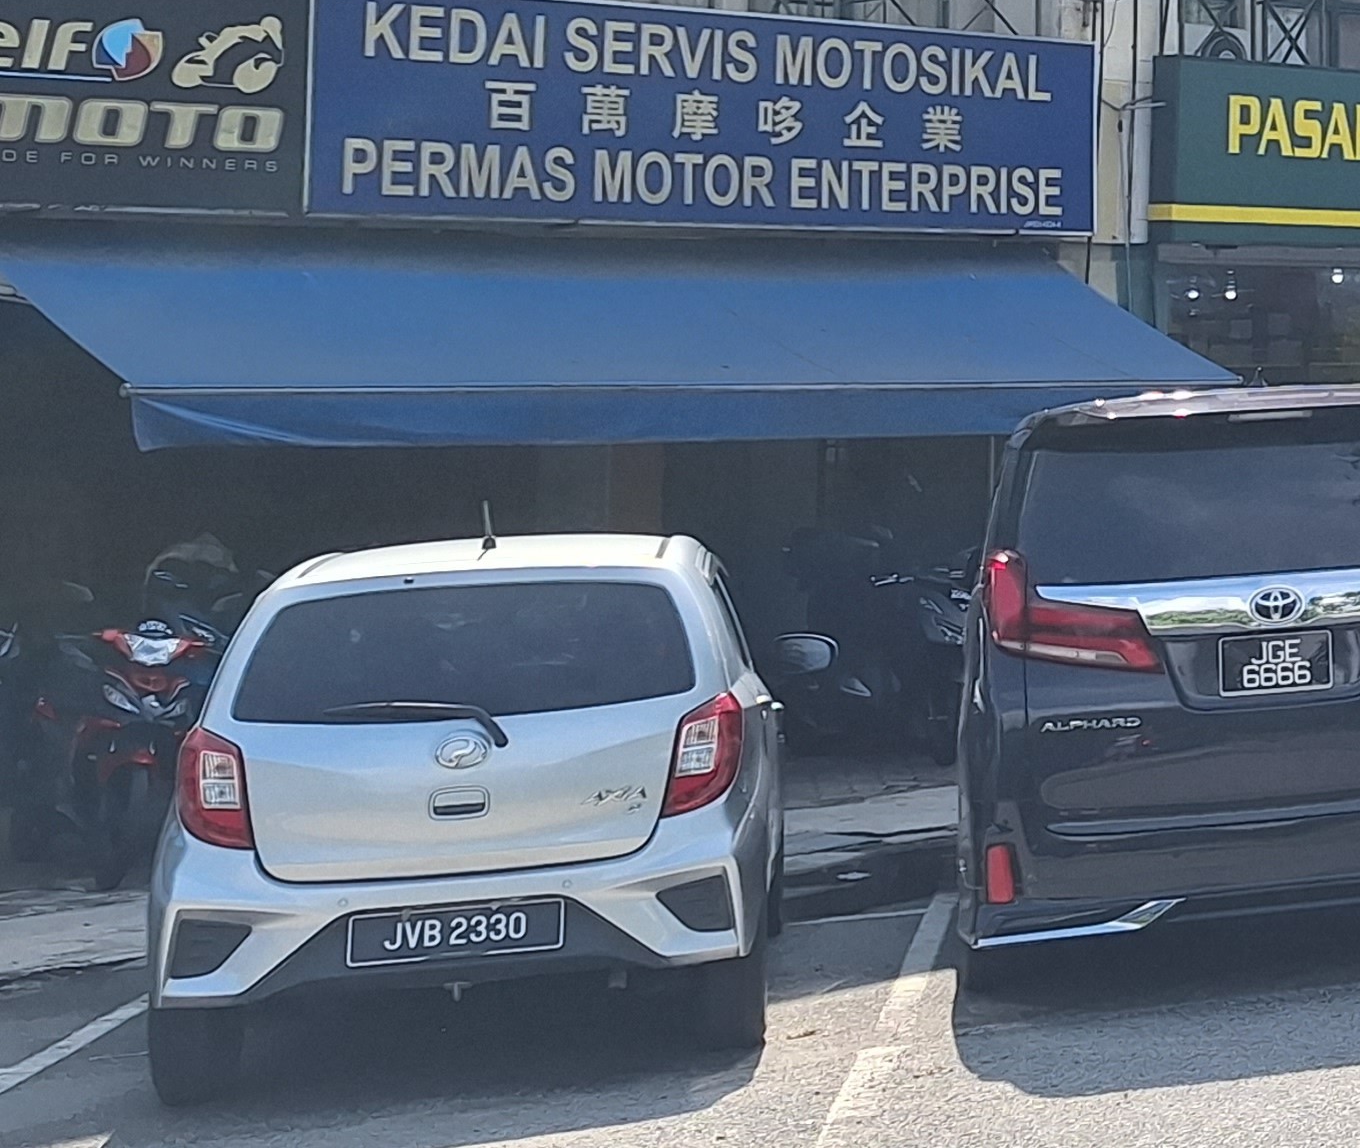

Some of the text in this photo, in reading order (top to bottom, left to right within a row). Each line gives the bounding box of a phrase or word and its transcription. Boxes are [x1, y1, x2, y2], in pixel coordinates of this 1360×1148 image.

[364, 1, 1052, 102] KEDAI SERVIS MOTOSIKAL
[485, 80, 963, 153] 百萬摩哆企業
[2, 151, 279, 172] DE FOR WINNERS
[341, 137, 1064, 216] PERMAS MOTOR ENTERPRISE
[1250, 639, 1303, 666] JGE
[1242, 661, 1312, 689] 6666
[1040, 715, 1143, 734] ALPHARD
[383, 911, 528, 951] JVB 2330
